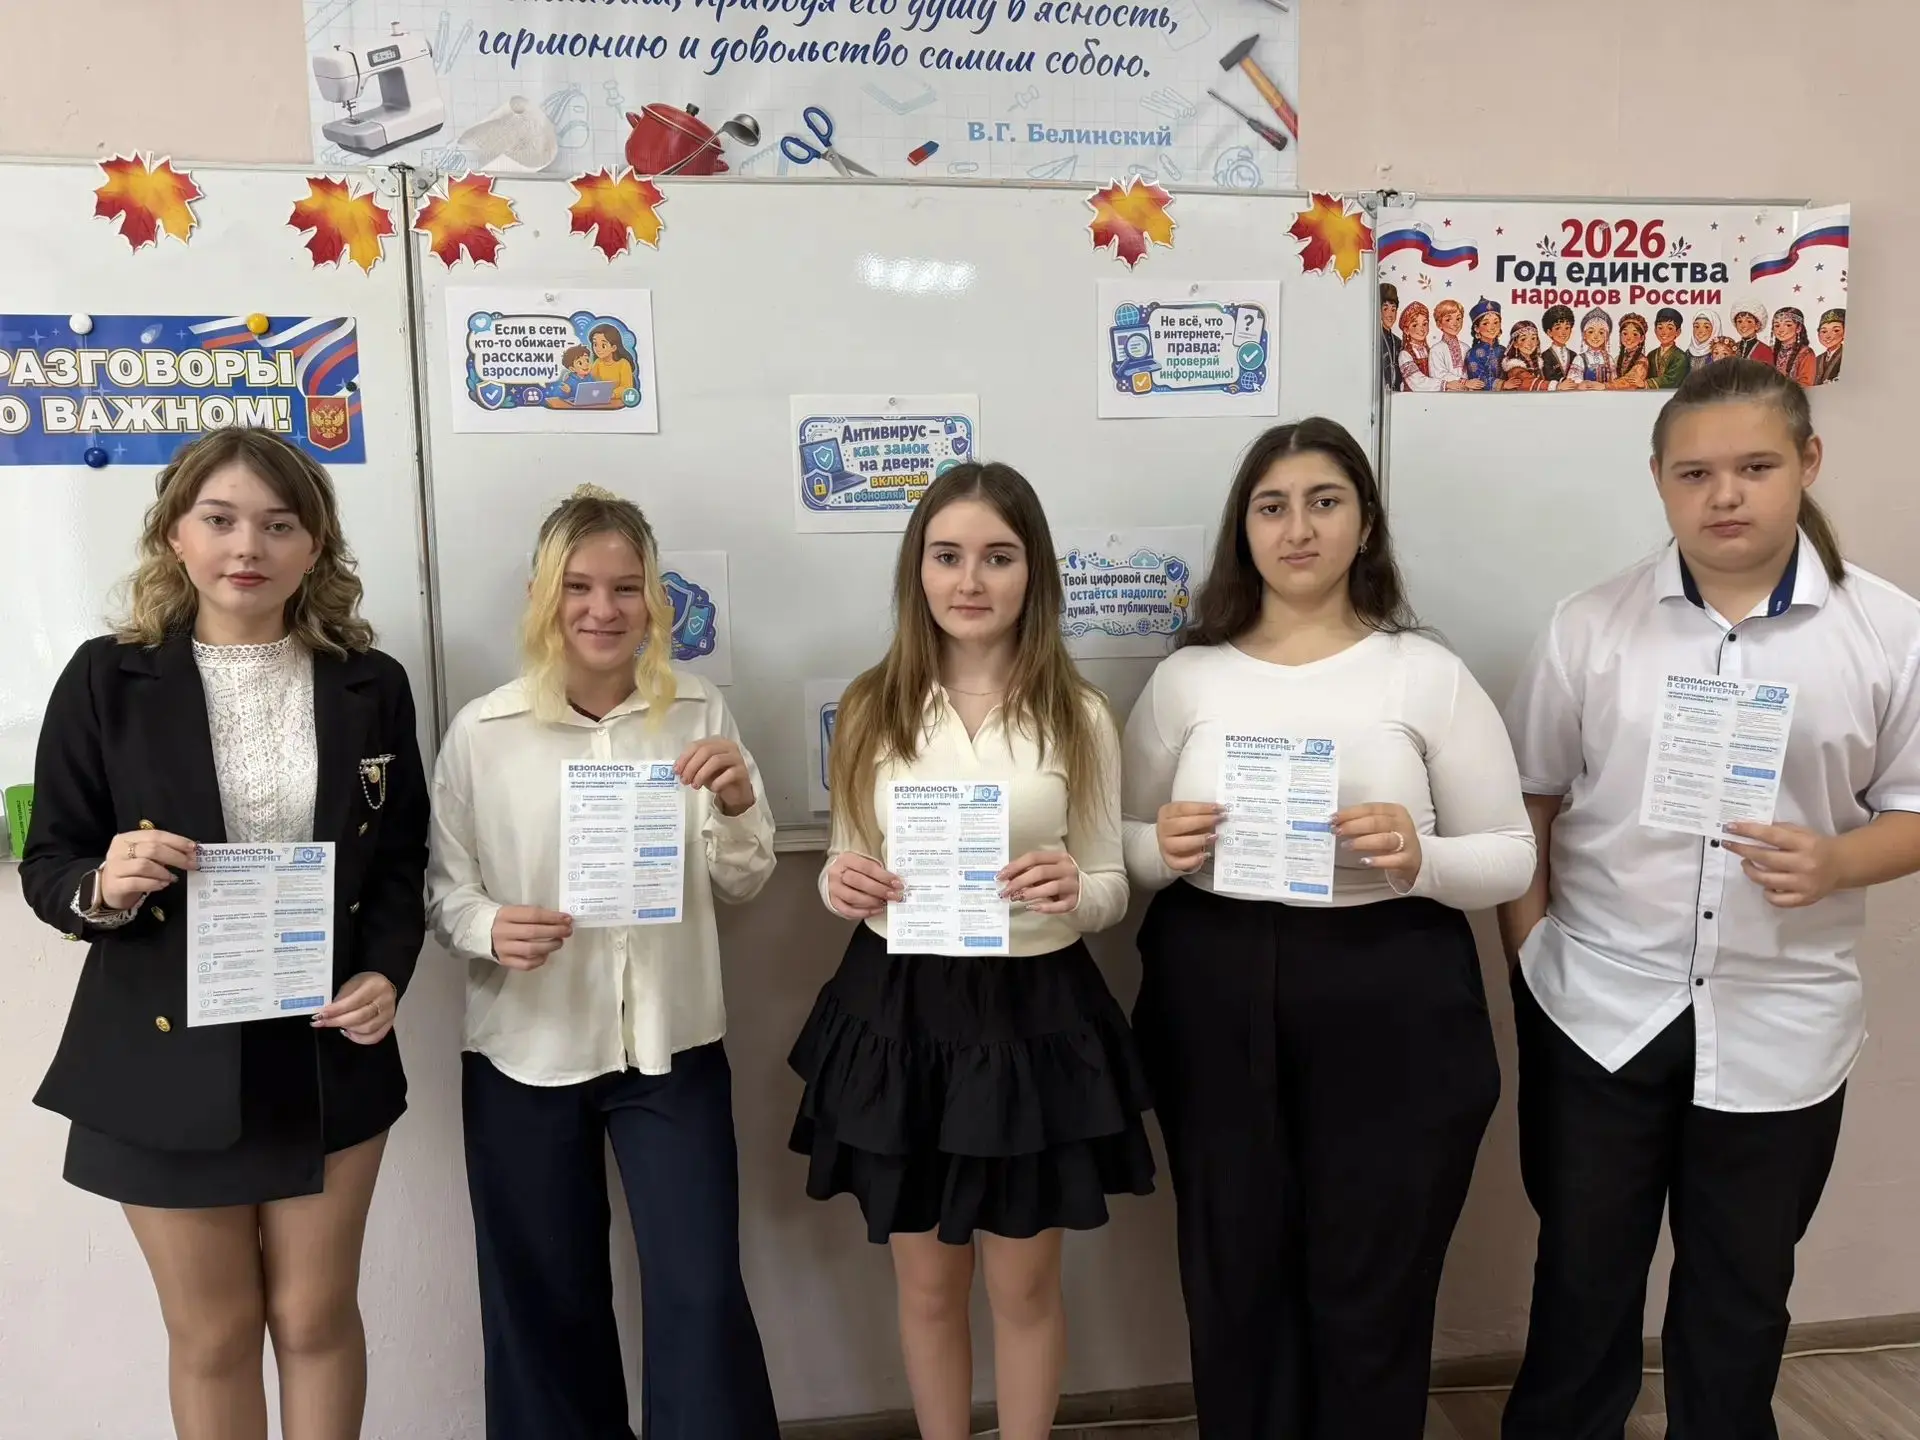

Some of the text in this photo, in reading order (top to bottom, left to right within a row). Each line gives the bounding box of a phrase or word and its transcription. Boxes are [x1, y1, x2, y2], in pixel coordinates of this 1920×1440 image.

[901, 0, 997, 34] душу
[1034, 1, 1178, 33] ясность,
[478, 24, 1151, 78] гармонию и довольство самим собою.
[967, 121, 1172, 147] В.Г. Белинский
[1561, 218, 1666, 259] 2026
[1496, 255, 1729, 286] Год единства
[1511, 285, 1721, 309] народов России
[1160, 315, 1223, 328] Не всё, что
[494, 324, 567, 335] Если в сети
[1154, 331, 1161, 339] в
[1163, 330, 1224, 340] интернете,
[474, 339, 512, 348] кто-то
[515, 337, 566, 348] обижает
[1167, 342, 1220, 355] правда:
[482, 352, 554, 365] расскажи
[1166, 355, 1220, 368] проверяй
[482, 364, 559, 379] взрослому!
[1159, 366, 1234, 381] информацию!
[0, 395, 293, 434] О ВАЖНОМ!
[841, 424, 927, 444] Антивирус
[853, 443, 930, 458] как замок
[860, 457, 935, 472] на двери:
[870, 471, 929, 488] включай
[845, 492, 853, 503] и
[854, 489, 906, 503] обновляй
[1062, 572, 1167, 586] Твой цифровой след
[1070, 588, 1167, 601] остаётся надолго:
[1067, 602, 1172, 618] думай, что публикуешь!
[1667, 675, 1739, 689] БЕЗОПАСНОСТЬ
[1699, 685, 1746, 697] ИНТЕРНЕТ
[1225, 735, 1289, 744] БЕЗОПАСНОСТЬ
[1255, 743, 1296, 751] ИНТЕРНЕТ
[233, 854, 282, 862] ИНТЕРНЕТ
